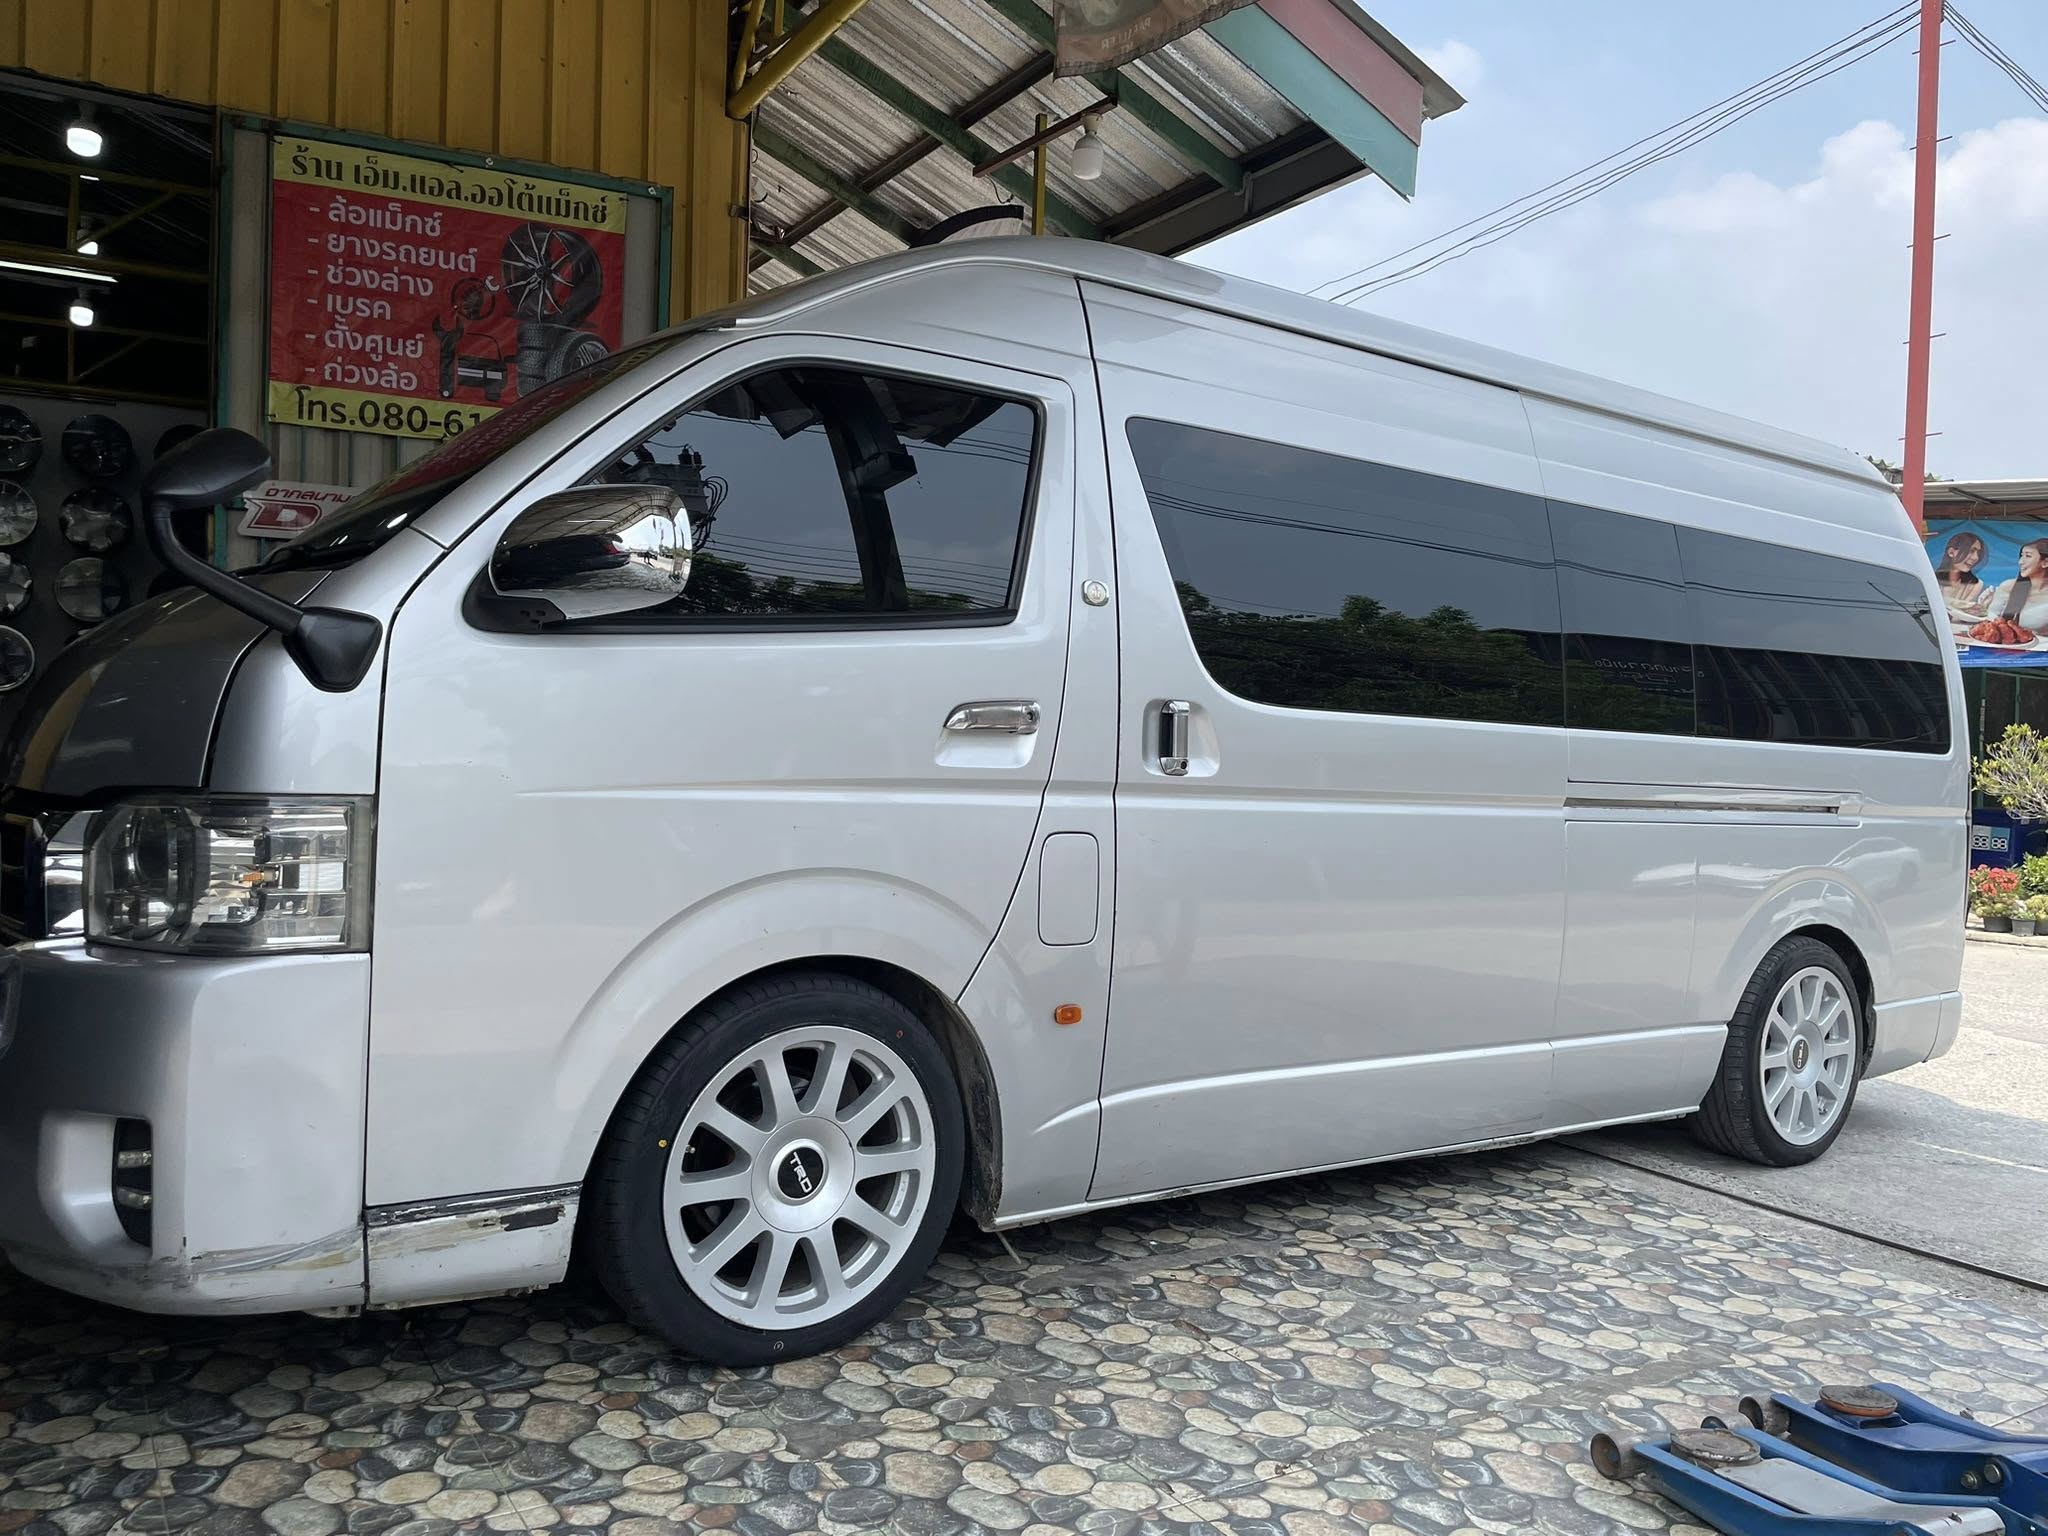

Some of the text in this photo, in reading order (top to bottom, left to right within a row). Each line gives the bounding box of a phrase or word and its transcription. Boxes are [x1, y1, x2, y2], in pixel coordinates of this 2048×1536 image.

[292, 145, 344, 182] ร้าน
[328, 195, 443, 237] ล้อแม็กซ์
[327, 233, 478, 273] ยางรถยนต์
[326, 258, 434, 297] ช่วงล่าง
[326, 293, 391, 321] เบรค
[324, 314, 425, 362] ตั้งศูนย์
[324, 356, 418, 391] ถ่วงล้อ
[790, 1151, 812, 1193] TRD
